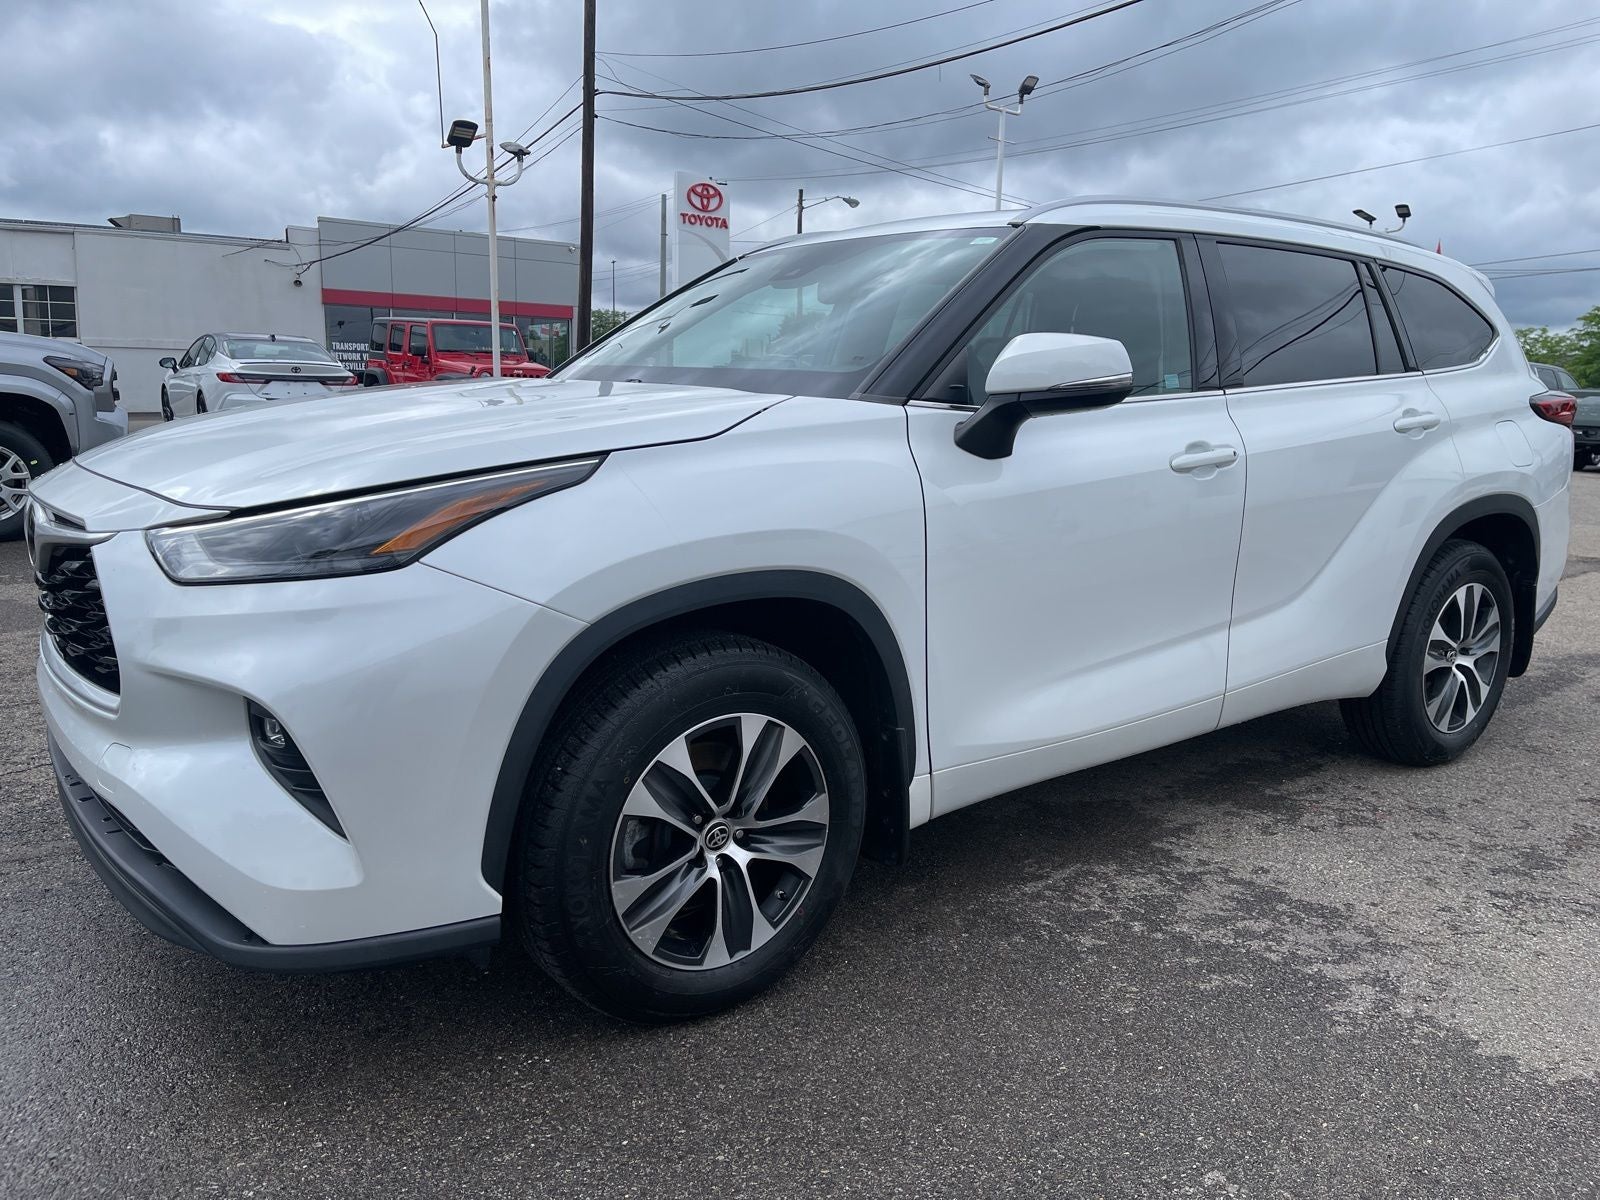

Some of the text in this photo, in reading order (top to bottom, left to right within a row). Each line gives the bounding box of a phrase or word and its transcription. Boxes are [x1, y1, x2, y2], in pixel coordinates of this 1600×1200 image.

[680, 212, 728, 229] TOYOTA
[332, 342, 369, 351] TRANSPORT
[341, 362, 366, 370] ESVILLE
[1420, 569, 1461, 635] YOKOHAMA
